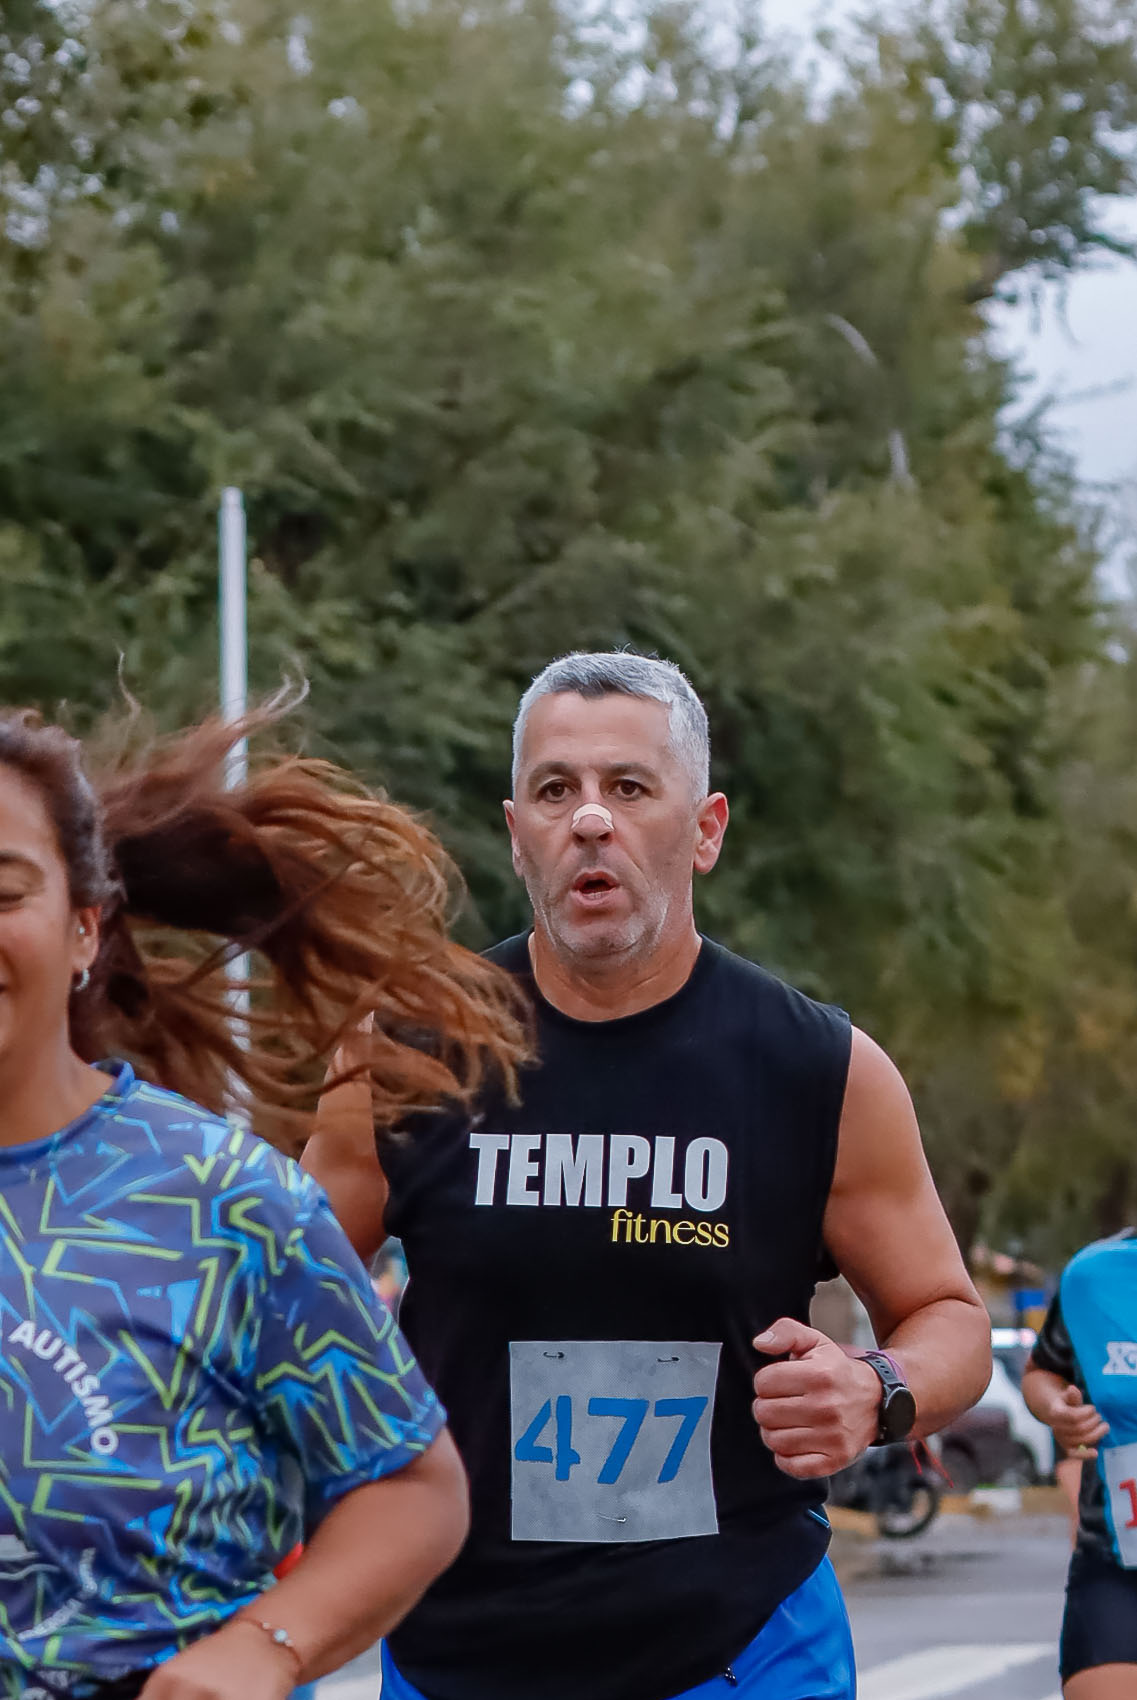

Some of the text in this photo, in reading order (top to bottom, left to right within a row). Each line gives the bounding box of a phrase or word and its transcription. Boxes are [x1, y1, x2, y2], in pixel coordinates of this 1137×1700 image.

[469, 1133, 728, 1212] TEMPLO
[611, 1209, 729, 1248] fitness
[8, 1320, 119, 1455] AUTISMO
[515, 1395, 708, 1485] 477
